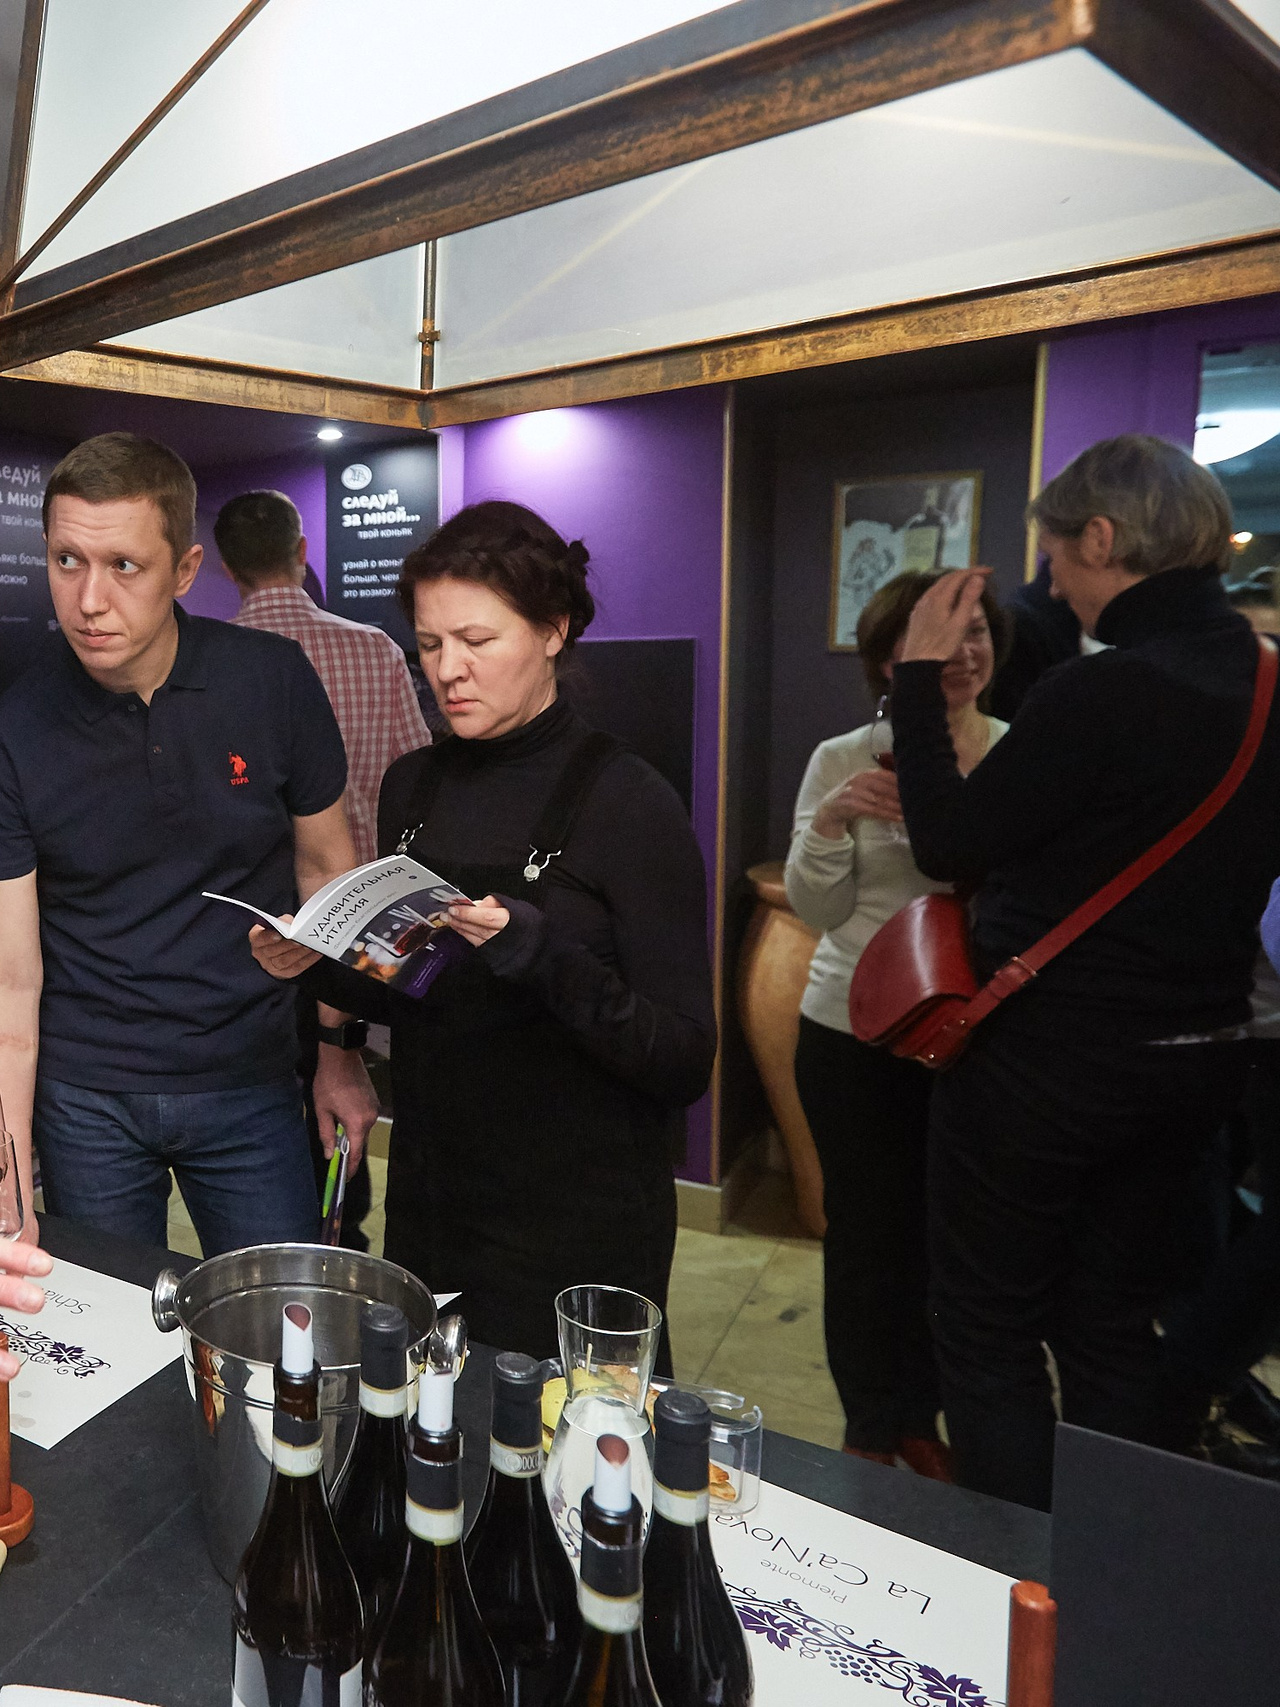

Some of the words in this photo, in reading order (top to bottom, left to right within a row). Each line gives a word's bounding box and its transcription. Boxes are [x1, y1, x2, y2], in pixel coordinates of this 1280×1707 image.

[341, 489, 399, 511] следуй
[1, 514, 23, 526] твой
[341, 513, 362, 527] за
[363, 506, 421, 526] мной...
[357, 528, 379, 539] твой
[380, 527, 413, 538] коньяк
[342, 558, 369, 571] узнай
[370, 560, 377, 569] о
[342, 573, 380, 585] больше,
[381, 572, 400, 582] чем
[343, 589, 358, 598] это
[308, 866, 406, 938] УДИВИТЕЛЬНАЯ
[322, 898, 369, 945] ИТАЛИЯ
[45, 1289, 91, 1315] Schia
[760, 1559, 848, 1604] Piemonte
[888, 1580, 932, 1615] La
